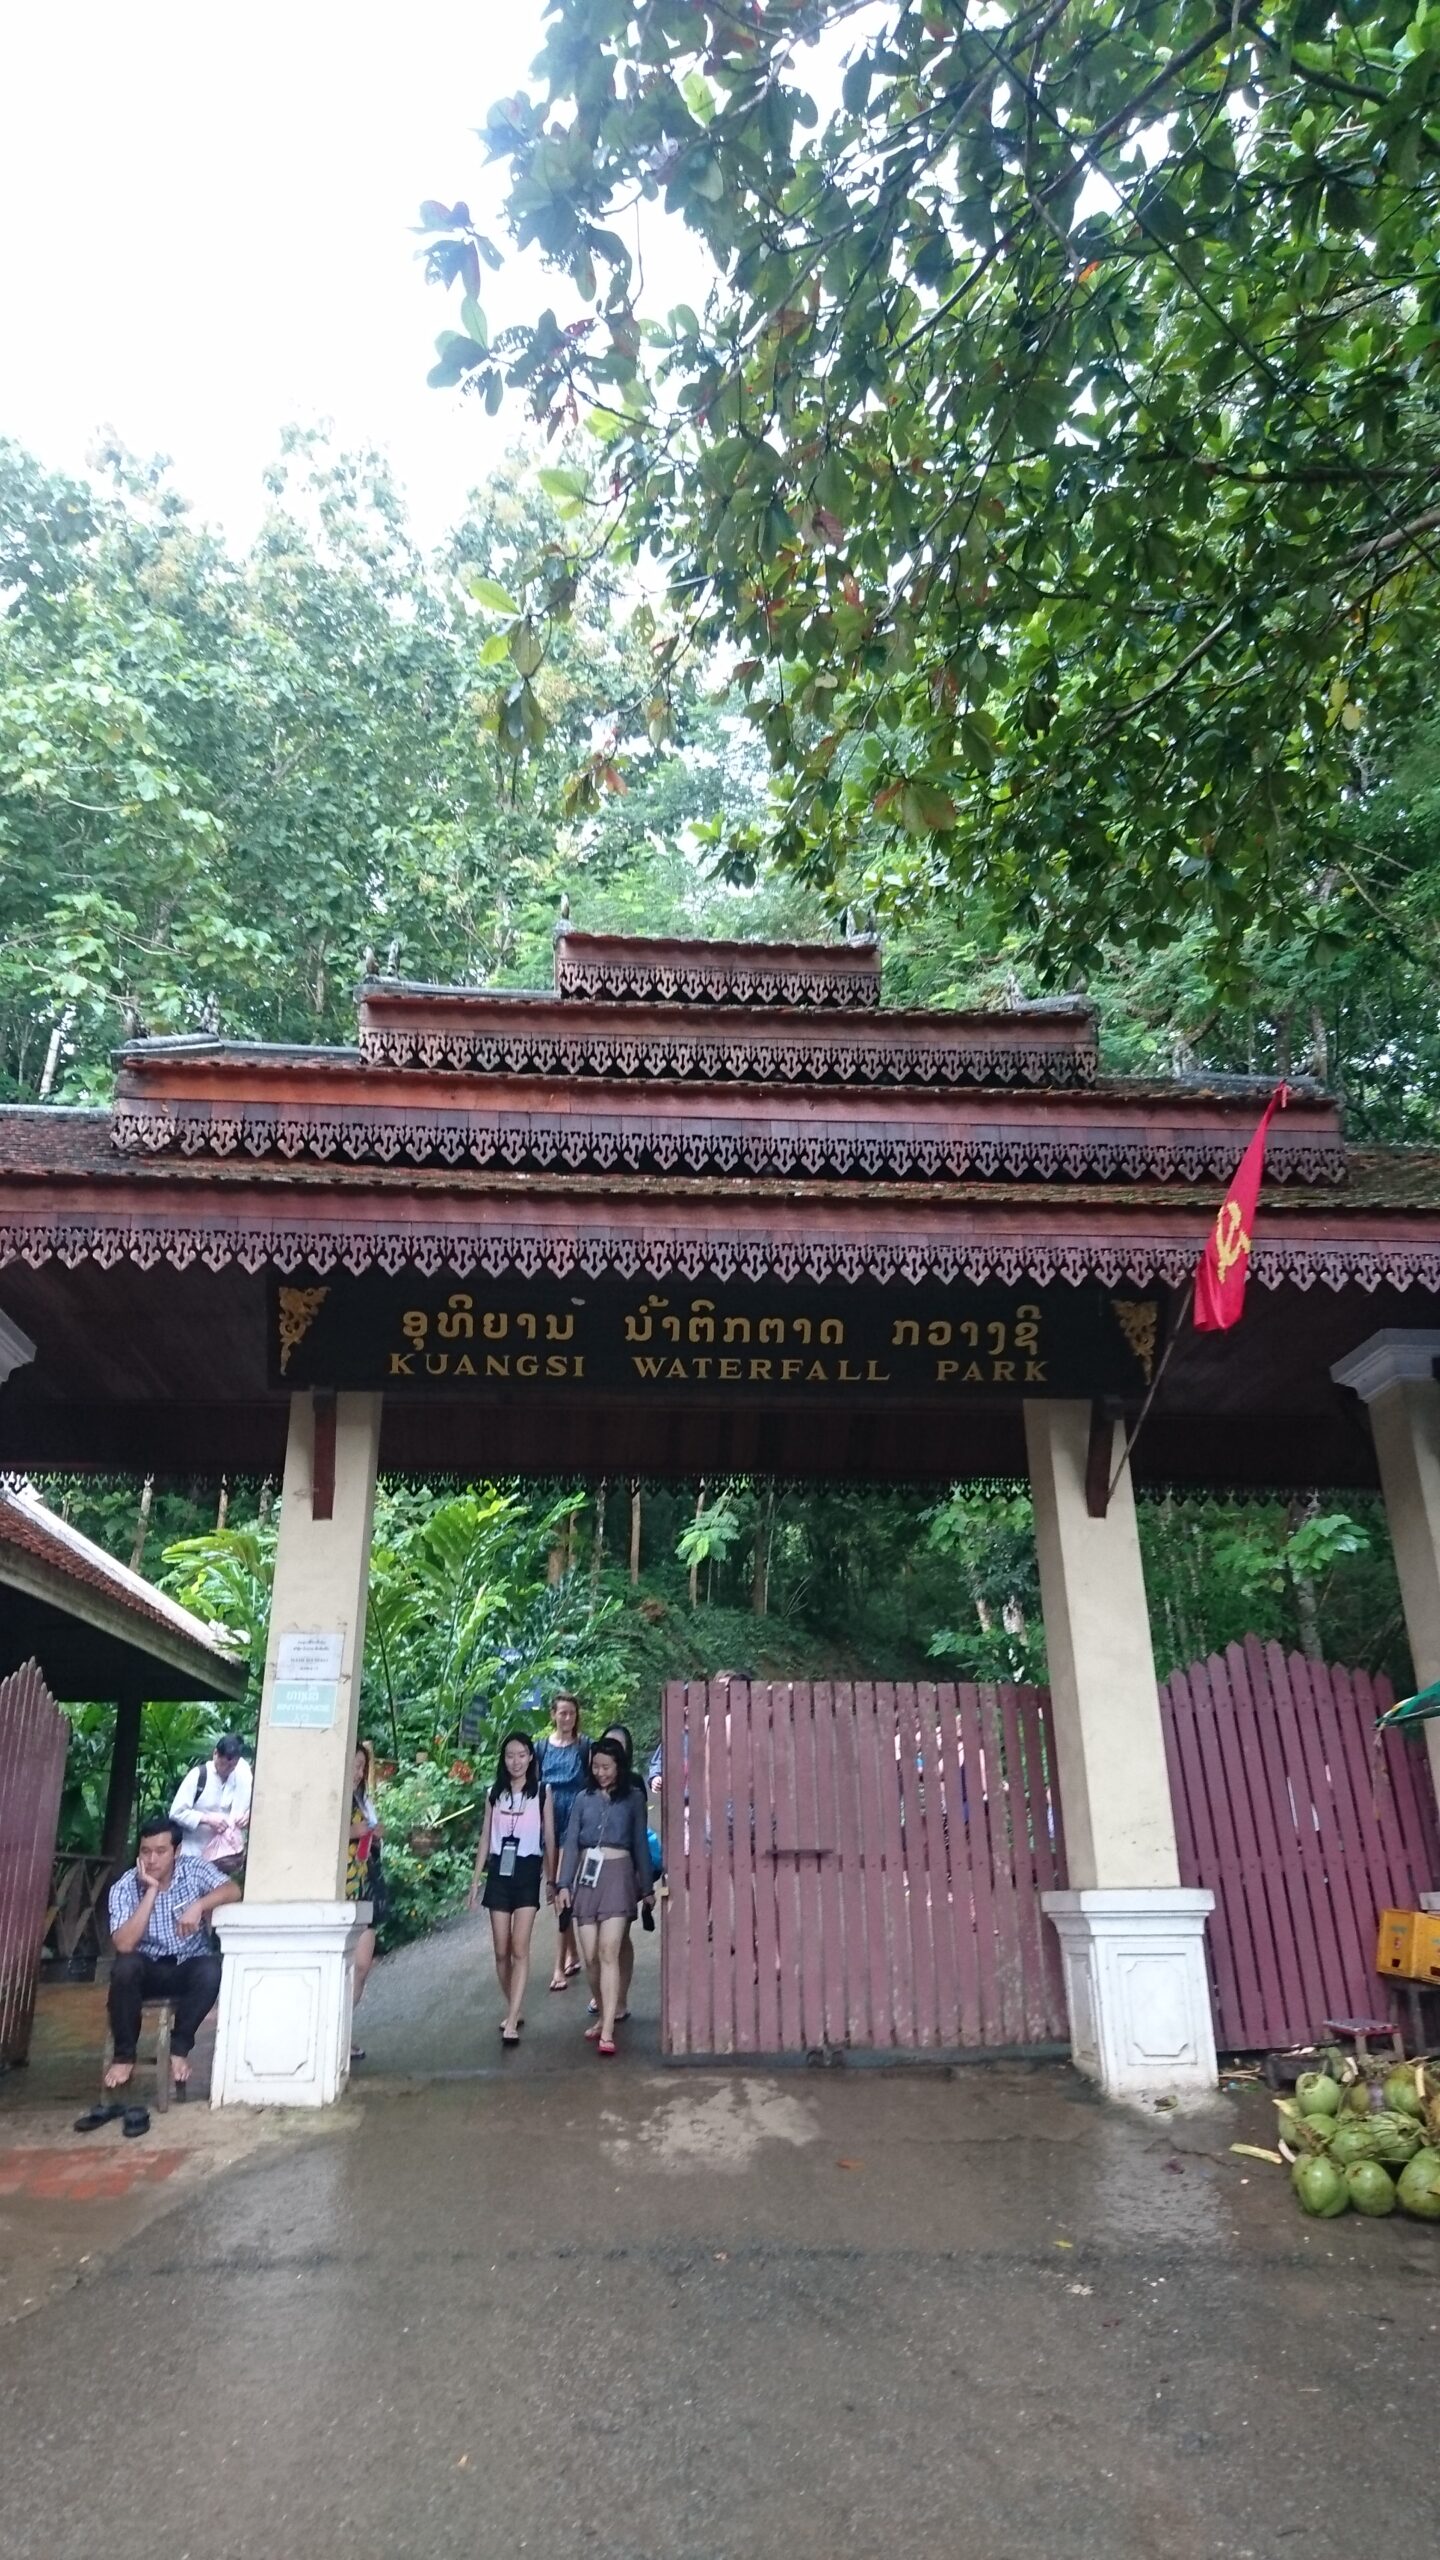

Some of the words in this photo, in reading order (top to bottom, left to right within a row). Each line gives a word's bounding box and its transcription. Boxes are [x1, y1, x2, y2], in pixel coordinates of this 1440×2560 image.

[389, 1353, 585, 1377] KUANGSI
[631, 1356, 891, 1381] WATERFALL
[936, 1360, 1049, 1382] PARK
